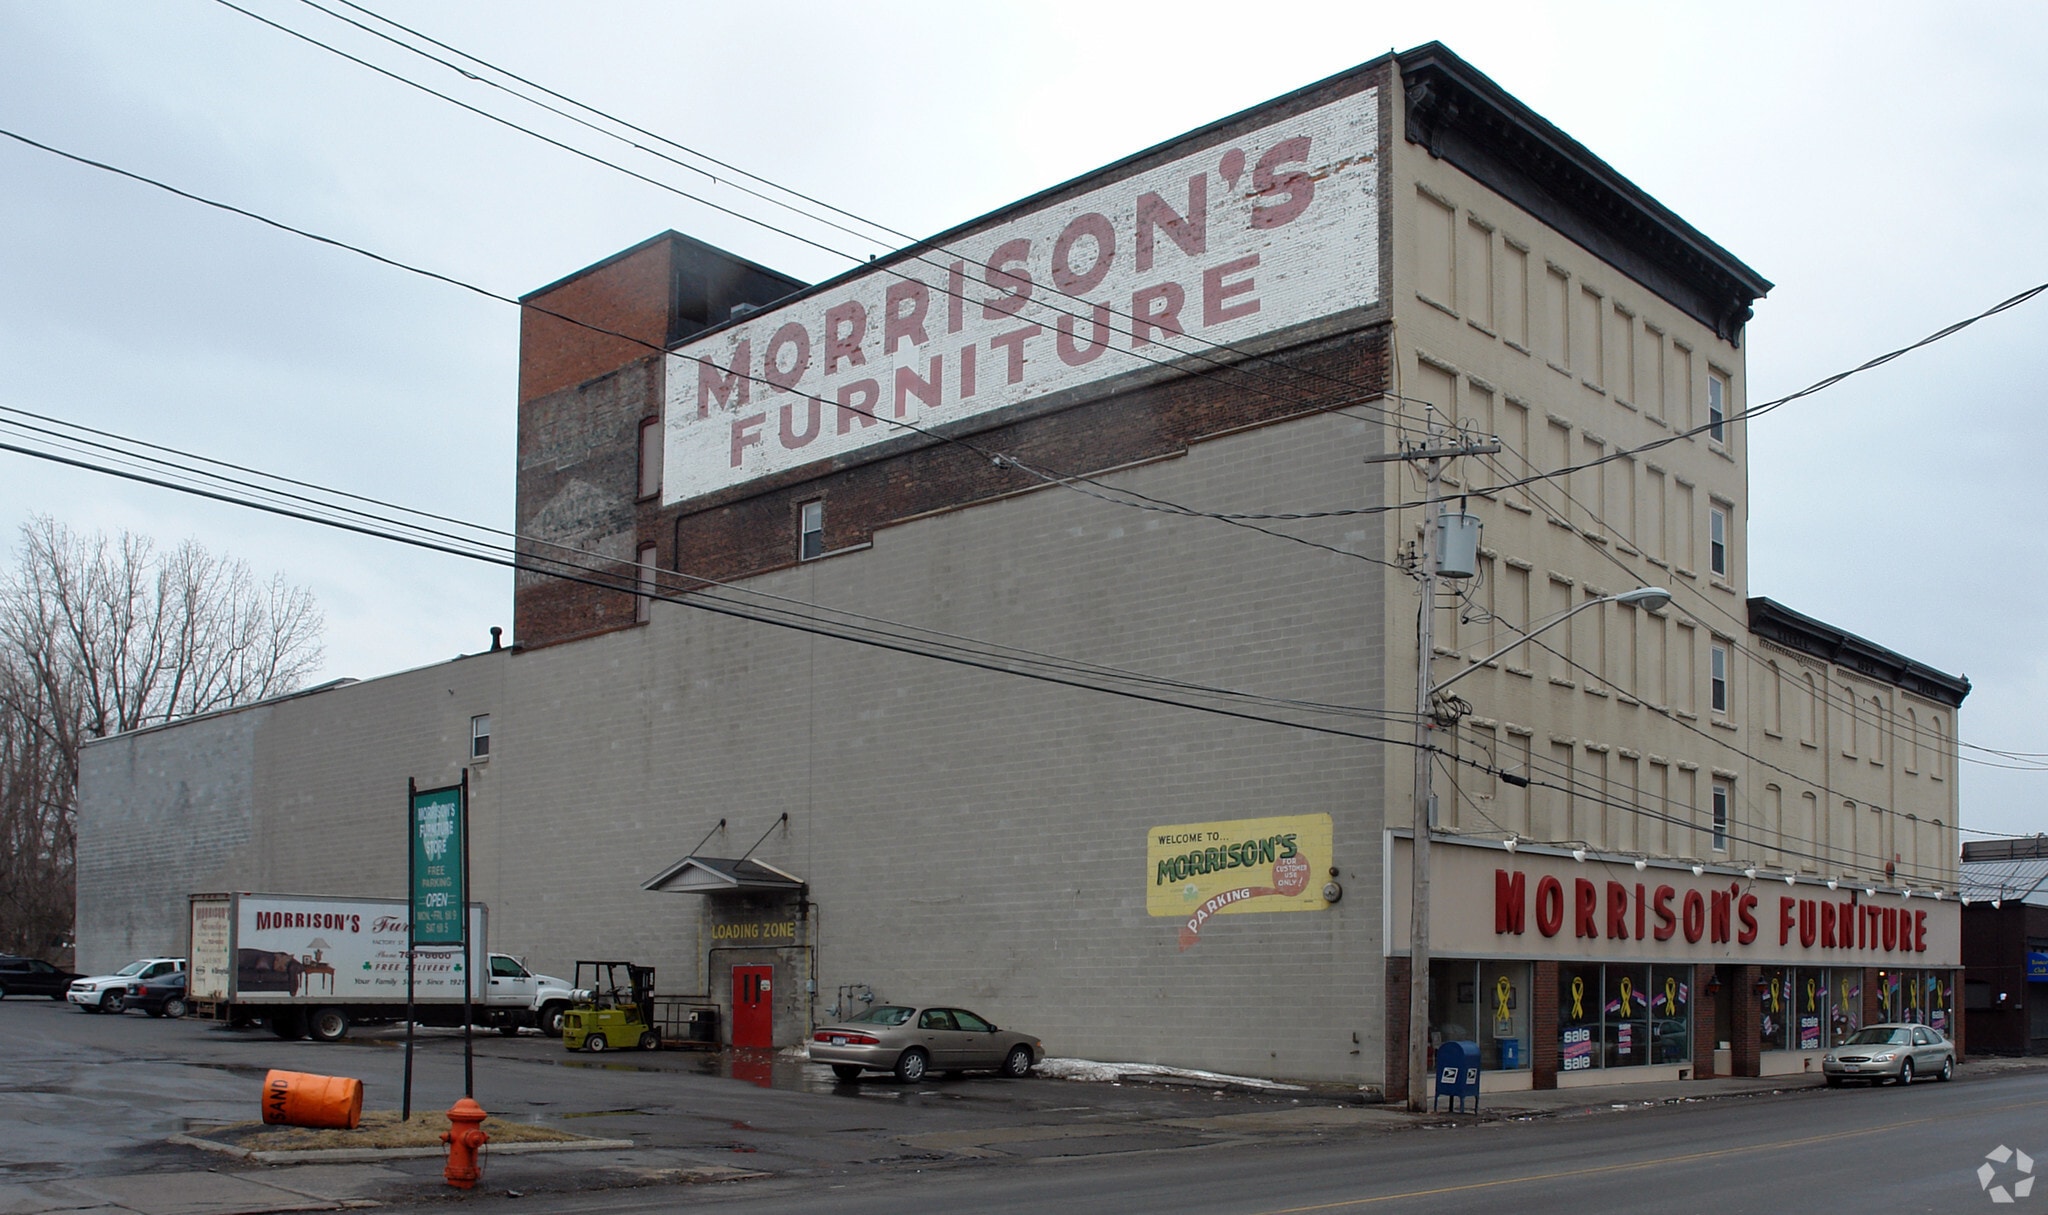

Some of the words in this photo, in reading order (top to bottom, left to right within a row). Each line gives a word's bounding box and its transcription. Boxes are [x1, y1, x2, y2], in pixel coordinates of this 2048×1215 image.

[696, 135, 1316, 421] MORRISON'S
[730, 253, 1261, 467] FURNITURE
[1158, 833, 1202, 844] WELCOME
[425, 839, 446, 854] STORE
[1157, 833, 1298, 885] MORRISON'S
[1282, 857, 1297, 865] FOR
[427, 865, 445, 875] FREE
[1275, 864, 1307, 872] CUSTOMER
[422, 877, 452, 888] PARKING
[426, 893, 448, 908] OPEN
[1187, 888, 1250, 934] PARKING
[1495, 868, 1759, 945] MORRISON'S
[1780, 896, 1928, 953] FURNITURE
[256, 911, 360, 934] MORRISON'S
[711, 923, 759, 939] LOADING
[763, 922, 794, 937] ZONE
[375, 963, 401, 971] FREE
[375, 978, 397, 986] Family
[1801, 1016, 1818, 1028] sale
[1563, 1029, 1590, 1043] sale
[1801, 1038, 1818, 1049] sale
[1563, 1055, 1590, 1070] sale
[269, 1079, 288, 1121] SAND
